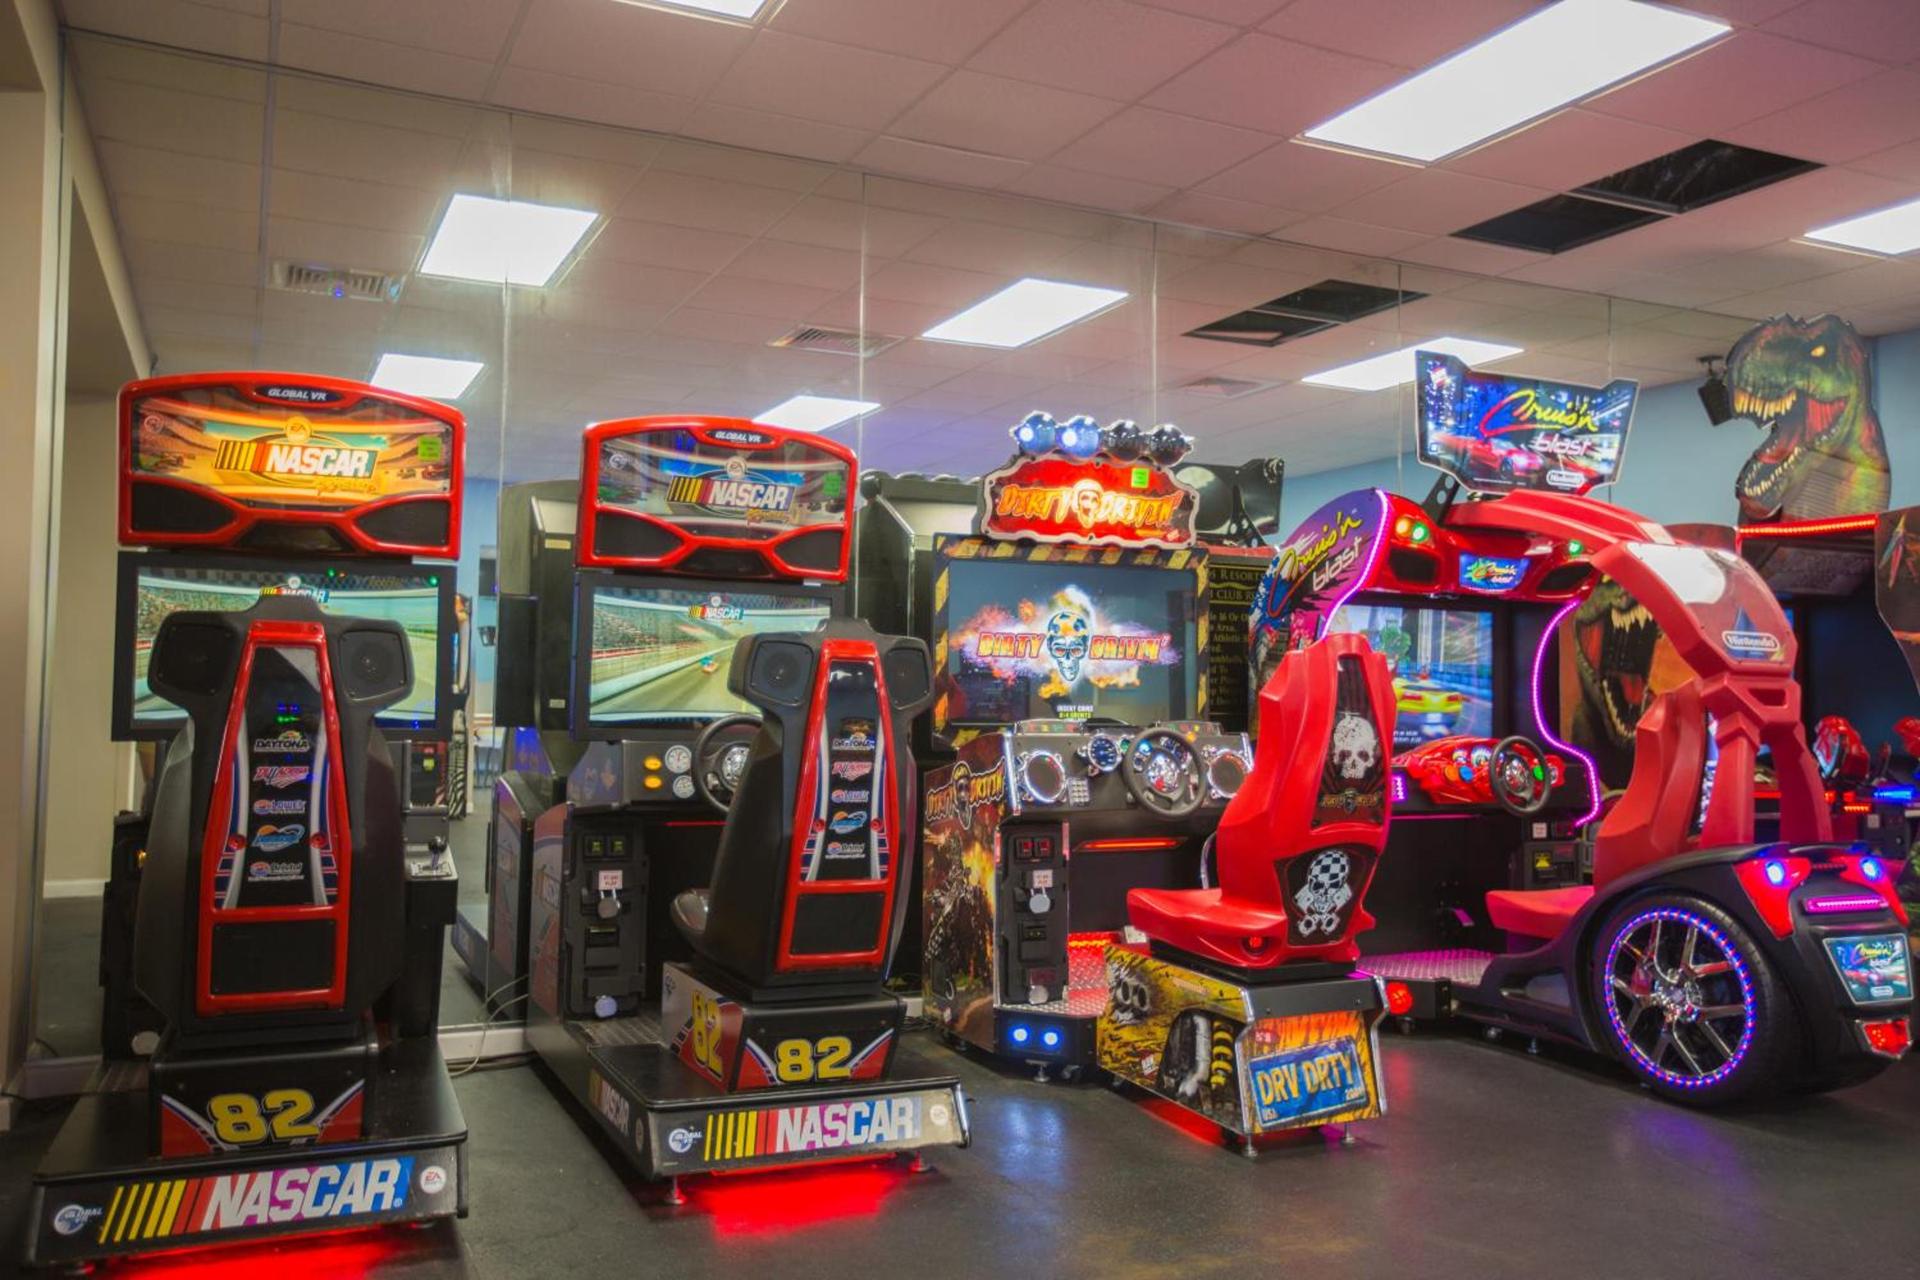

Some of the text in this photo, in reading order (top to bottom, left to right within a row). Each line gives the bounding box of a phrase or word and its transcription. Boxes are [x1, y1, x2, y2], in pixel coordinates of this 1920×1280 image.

[267, 388, 328, 401] GLOBAL VR
[715, 431, 762, 443] GLOBAL VR
[265, 445, 370, 477] NASCAR
[707, 481, 789, 511] NASCAR
[705, 607, 741, 620] NASCAR
[977, 632, 1045, 659] DIRTY
[1727, 634, 1776, 648] Nintendo
[255, 738, 309, 748] DAYTONA
[776, 1036, 852, 1082] 82
[1256, 1052, 1354, 1106] DRV DRTY
[207, 1088, 321, 1145] 82
[775, 1096, 914, 1153] NASCAR
[200, 1158, 401, 1231] NASCAR
